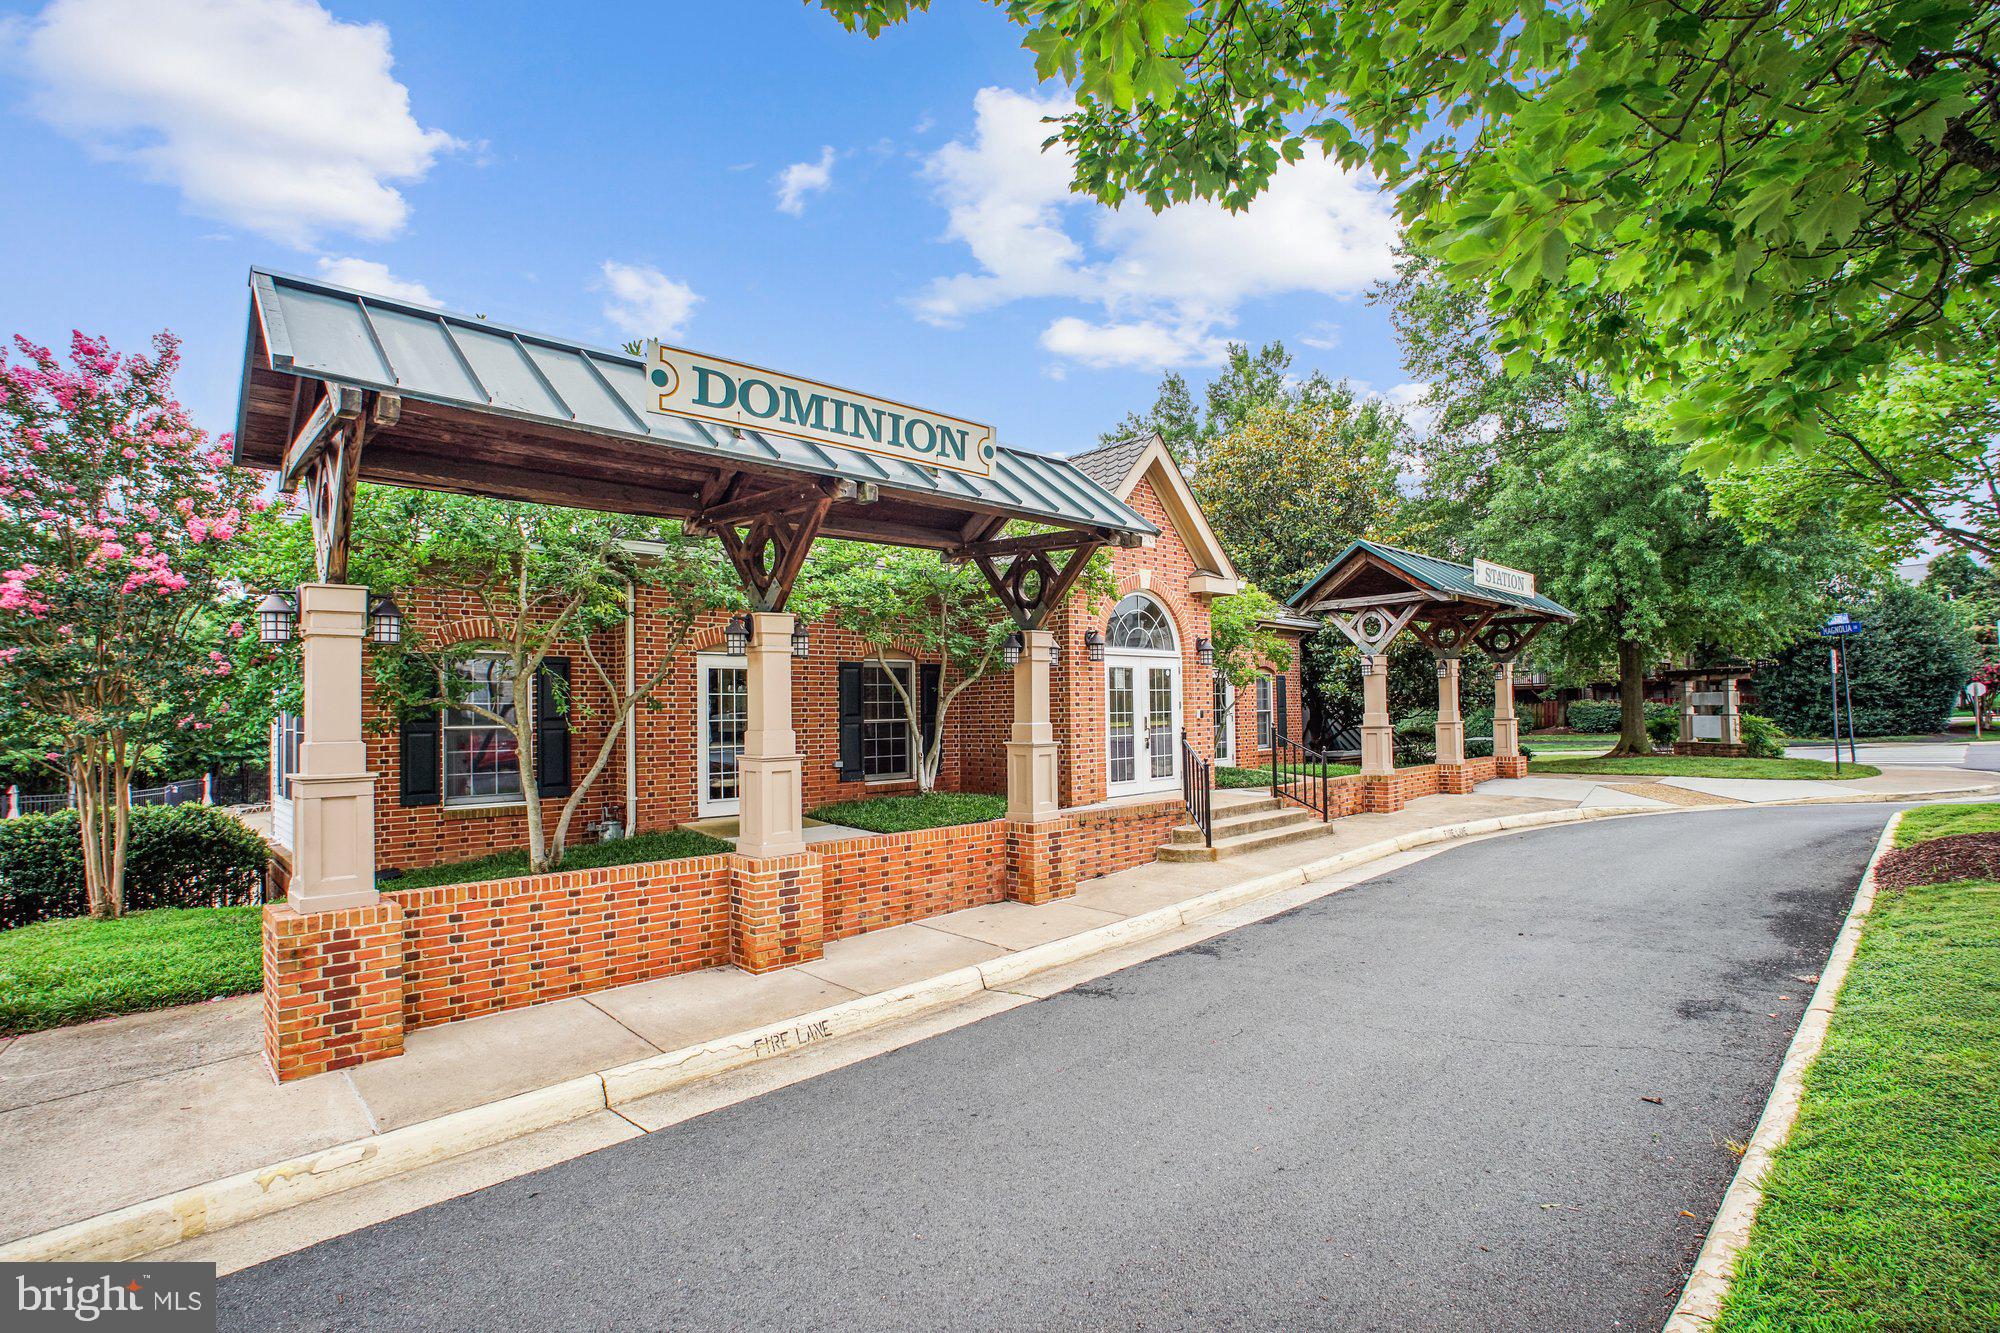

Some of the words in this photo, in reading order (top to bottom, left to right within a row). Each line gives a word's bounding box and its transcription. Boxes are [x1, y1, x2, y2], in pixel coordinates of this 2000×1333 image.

[692, 365, 969, 462] DOMINION
[1485, 567, 1524, 591] STATION
[1823, 624, 1852, 635] MAGNOLIA
[753, 1031, 788, 1057] FIRE
[795, 1020, 833, 1045] LANE
